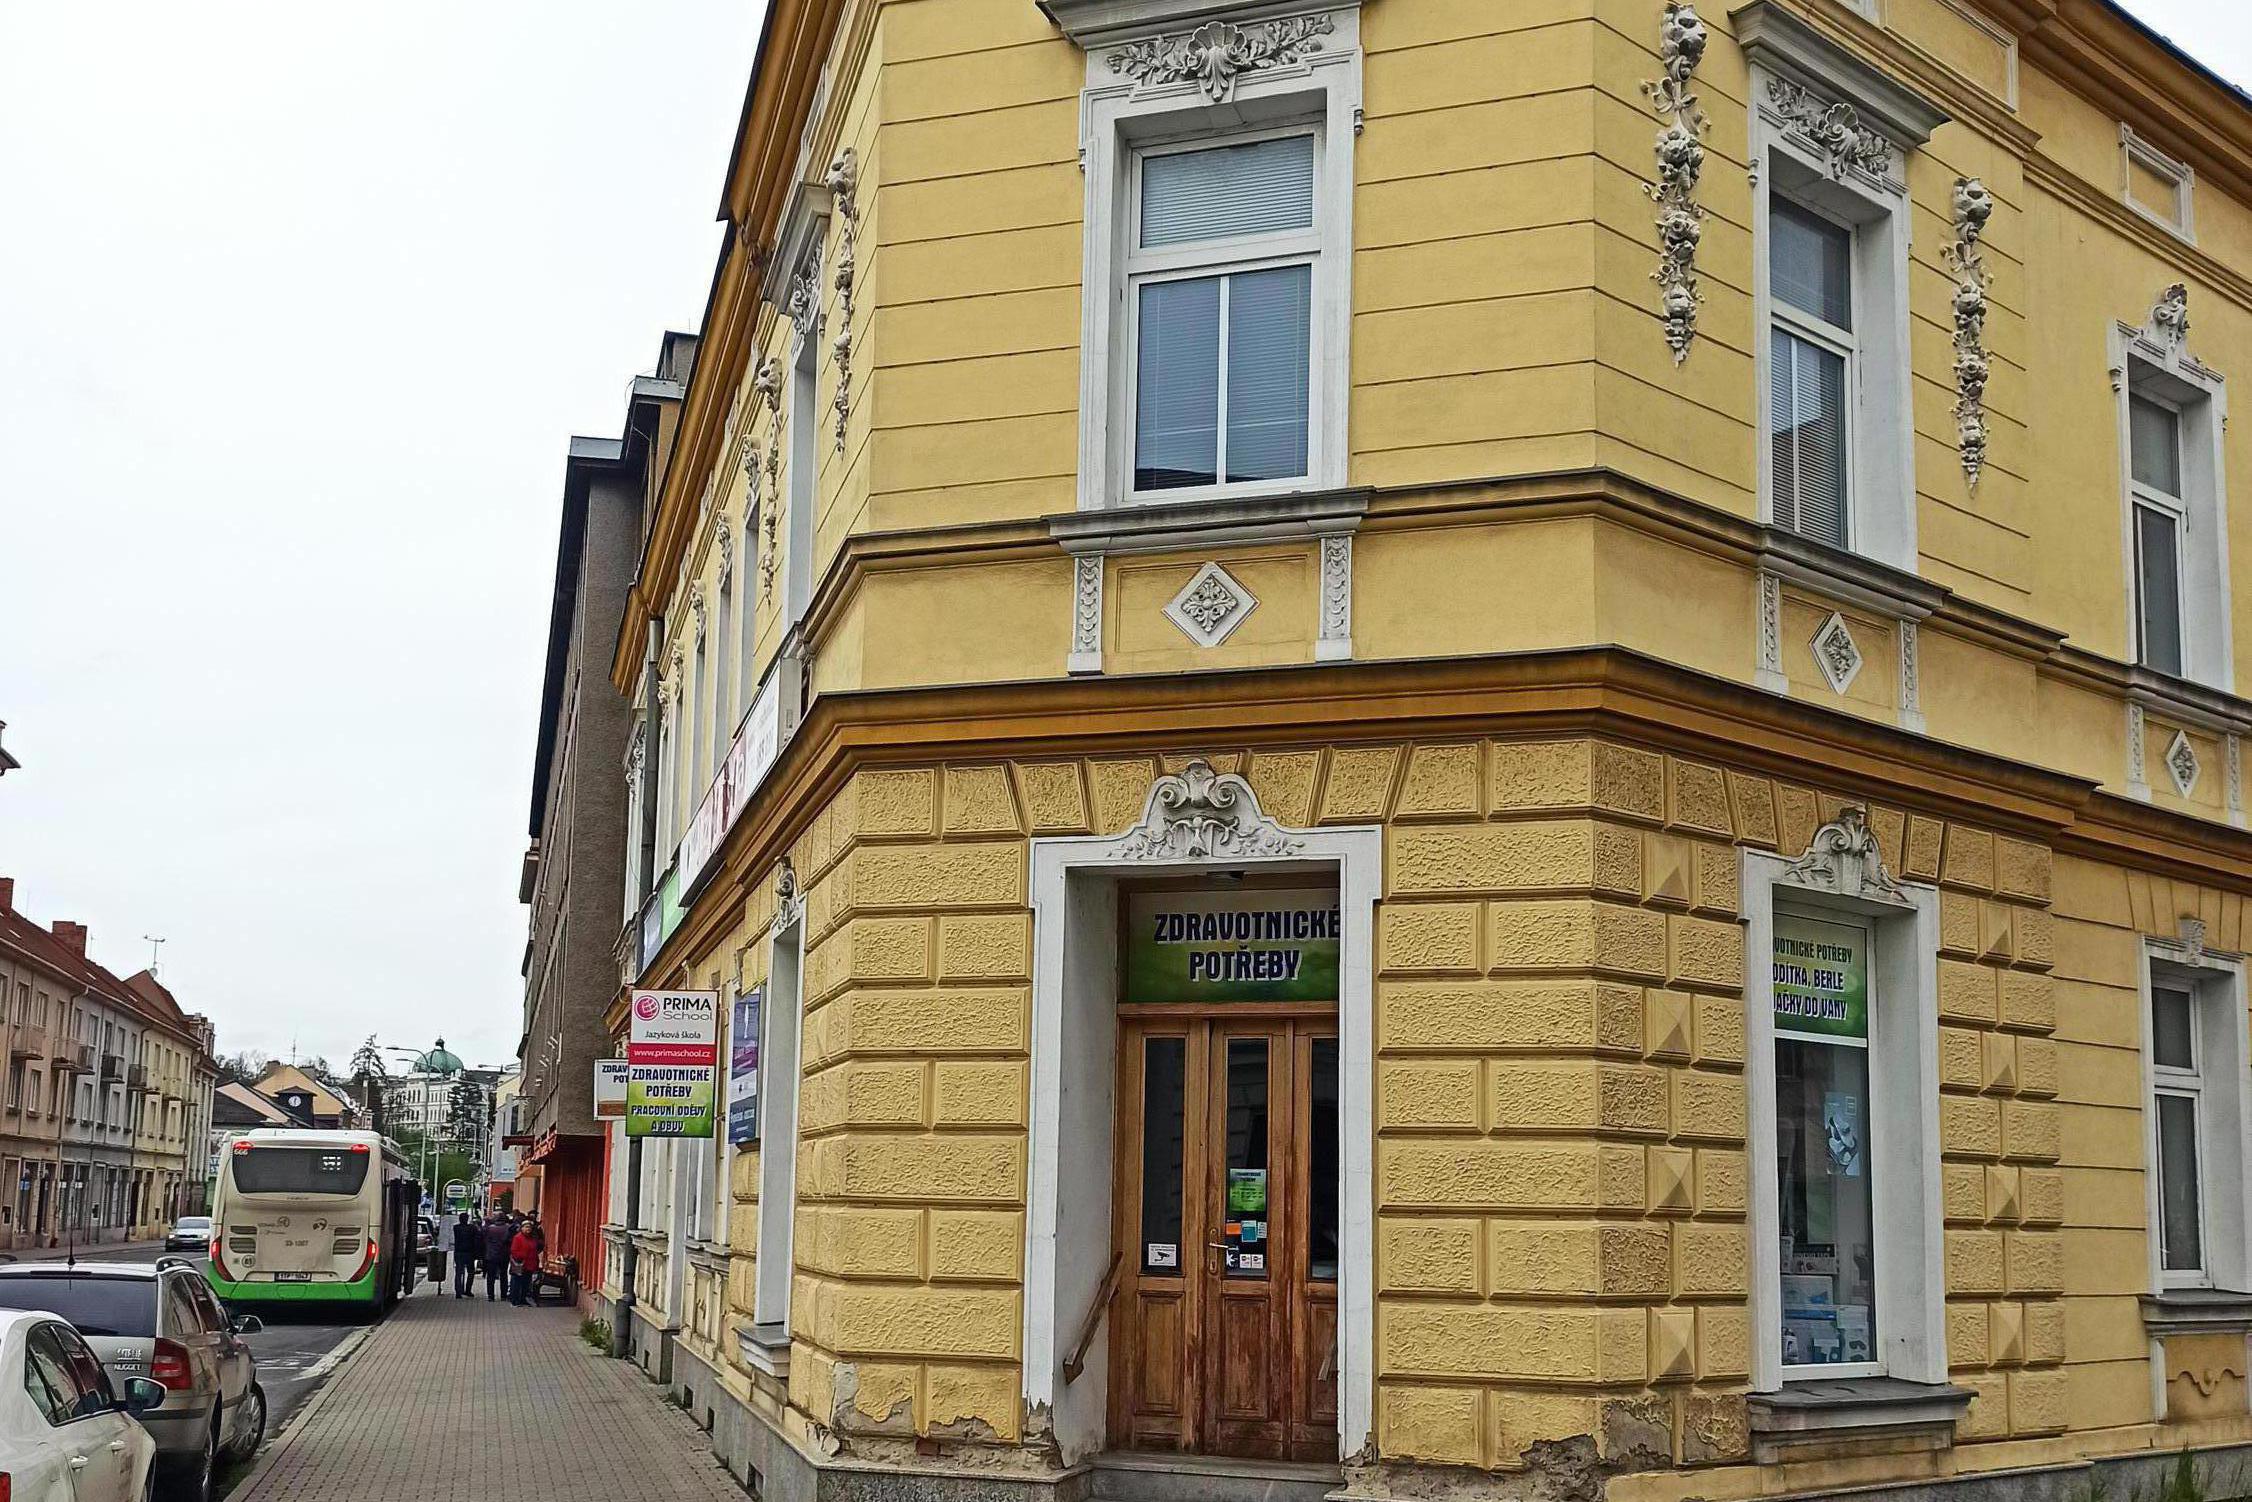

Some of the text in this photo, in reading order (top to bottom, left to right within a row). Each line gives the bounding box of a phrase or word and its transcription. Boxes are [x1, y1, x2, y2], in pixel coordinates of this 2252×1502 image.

[1153, 905, 1340, 942] ZDRAVOTNICKÉ
[1773, 937, 1852, 963] VOTNICKÉ POTŘEBY
[1189, 945, 1301, 982] POTŘEBY
[1814, 969, 1844, 991] BERLE
[663, 997, 711, 1011] PRIMA
[1773, 990, 1847, 1020] AČKY DO VANY
[663, 1011, 713, 1021] School
[645, 1030, 701, 1039] Jazyková škola
[633, 1049, 711, 1058] www.primaschool.cz
[631, 1067, 710, 1081] ZDRAVOTNICKÉ
[646, 1083, 692, 1098] POTŘEBY
[631, 1103, 707, 1117] PRACOVNÍ ODĚVY
[651, 1121, 685, 1132] A OBUV
